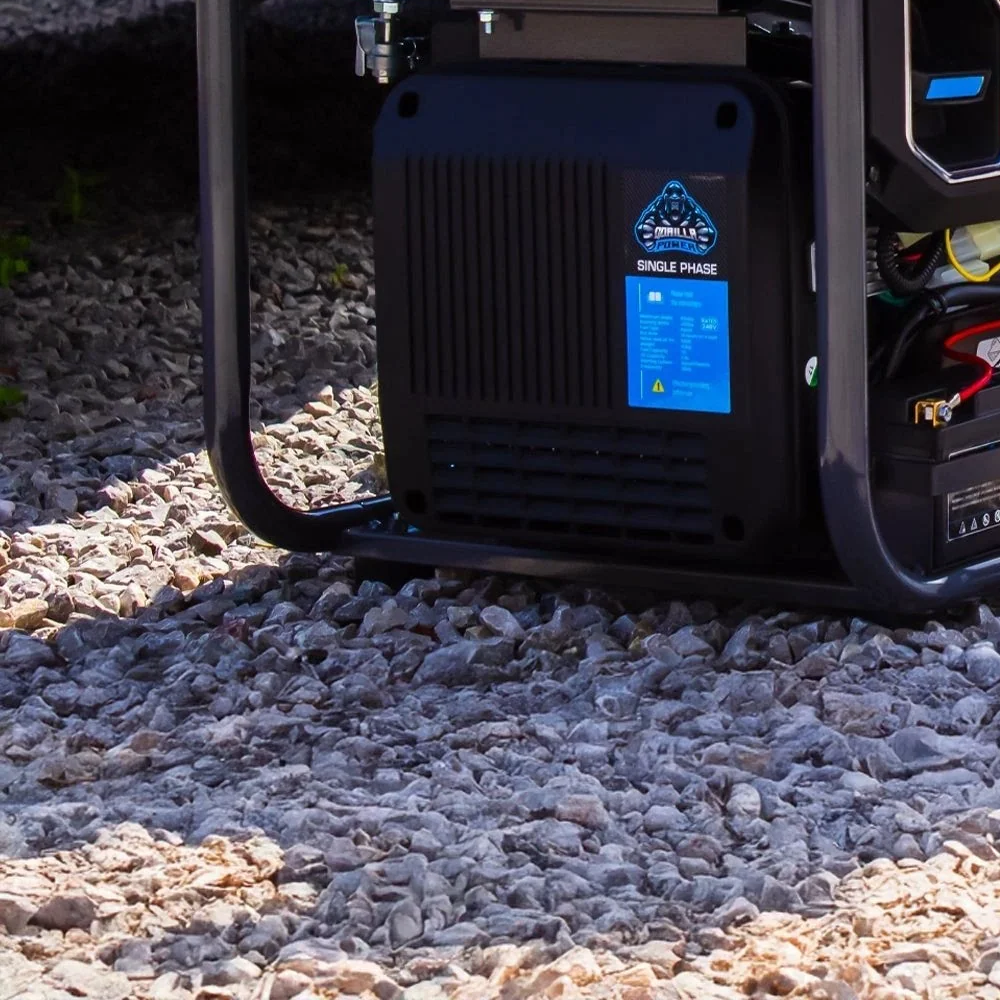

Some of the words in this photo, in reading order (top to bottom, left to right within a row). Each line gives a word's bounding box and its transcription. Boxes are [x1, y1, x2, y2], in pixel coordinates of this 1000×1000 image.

[654, 226, 699, 241] GORILLA
[656, 240, 697, 251] POWER
[637, 259, 677, 273] SINGLE
[680, 261, 718, 275] PHASE
